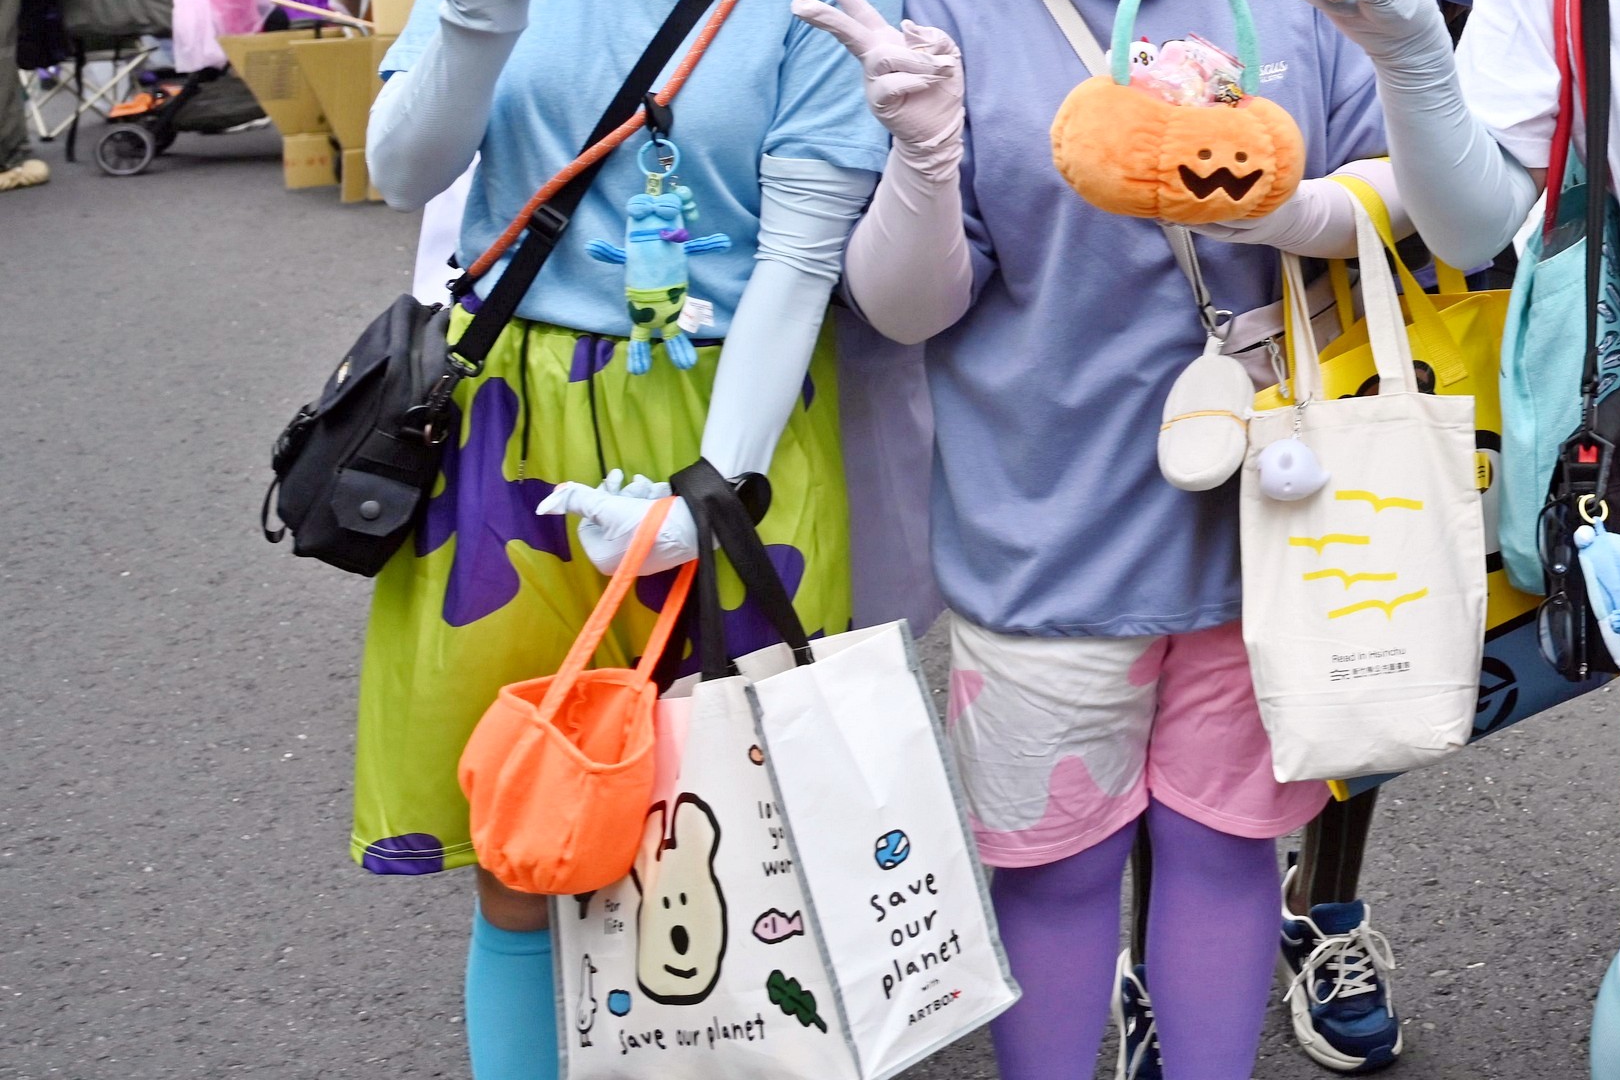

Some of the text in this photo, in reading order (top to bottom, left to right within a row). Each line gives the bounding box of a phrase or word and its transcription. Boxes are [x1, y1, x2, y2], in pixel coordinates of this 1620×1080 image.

[890, 909, 938, 948] our
[882, 928, 962, 1001] planet
[707, 1014, 765, 1050] planet
